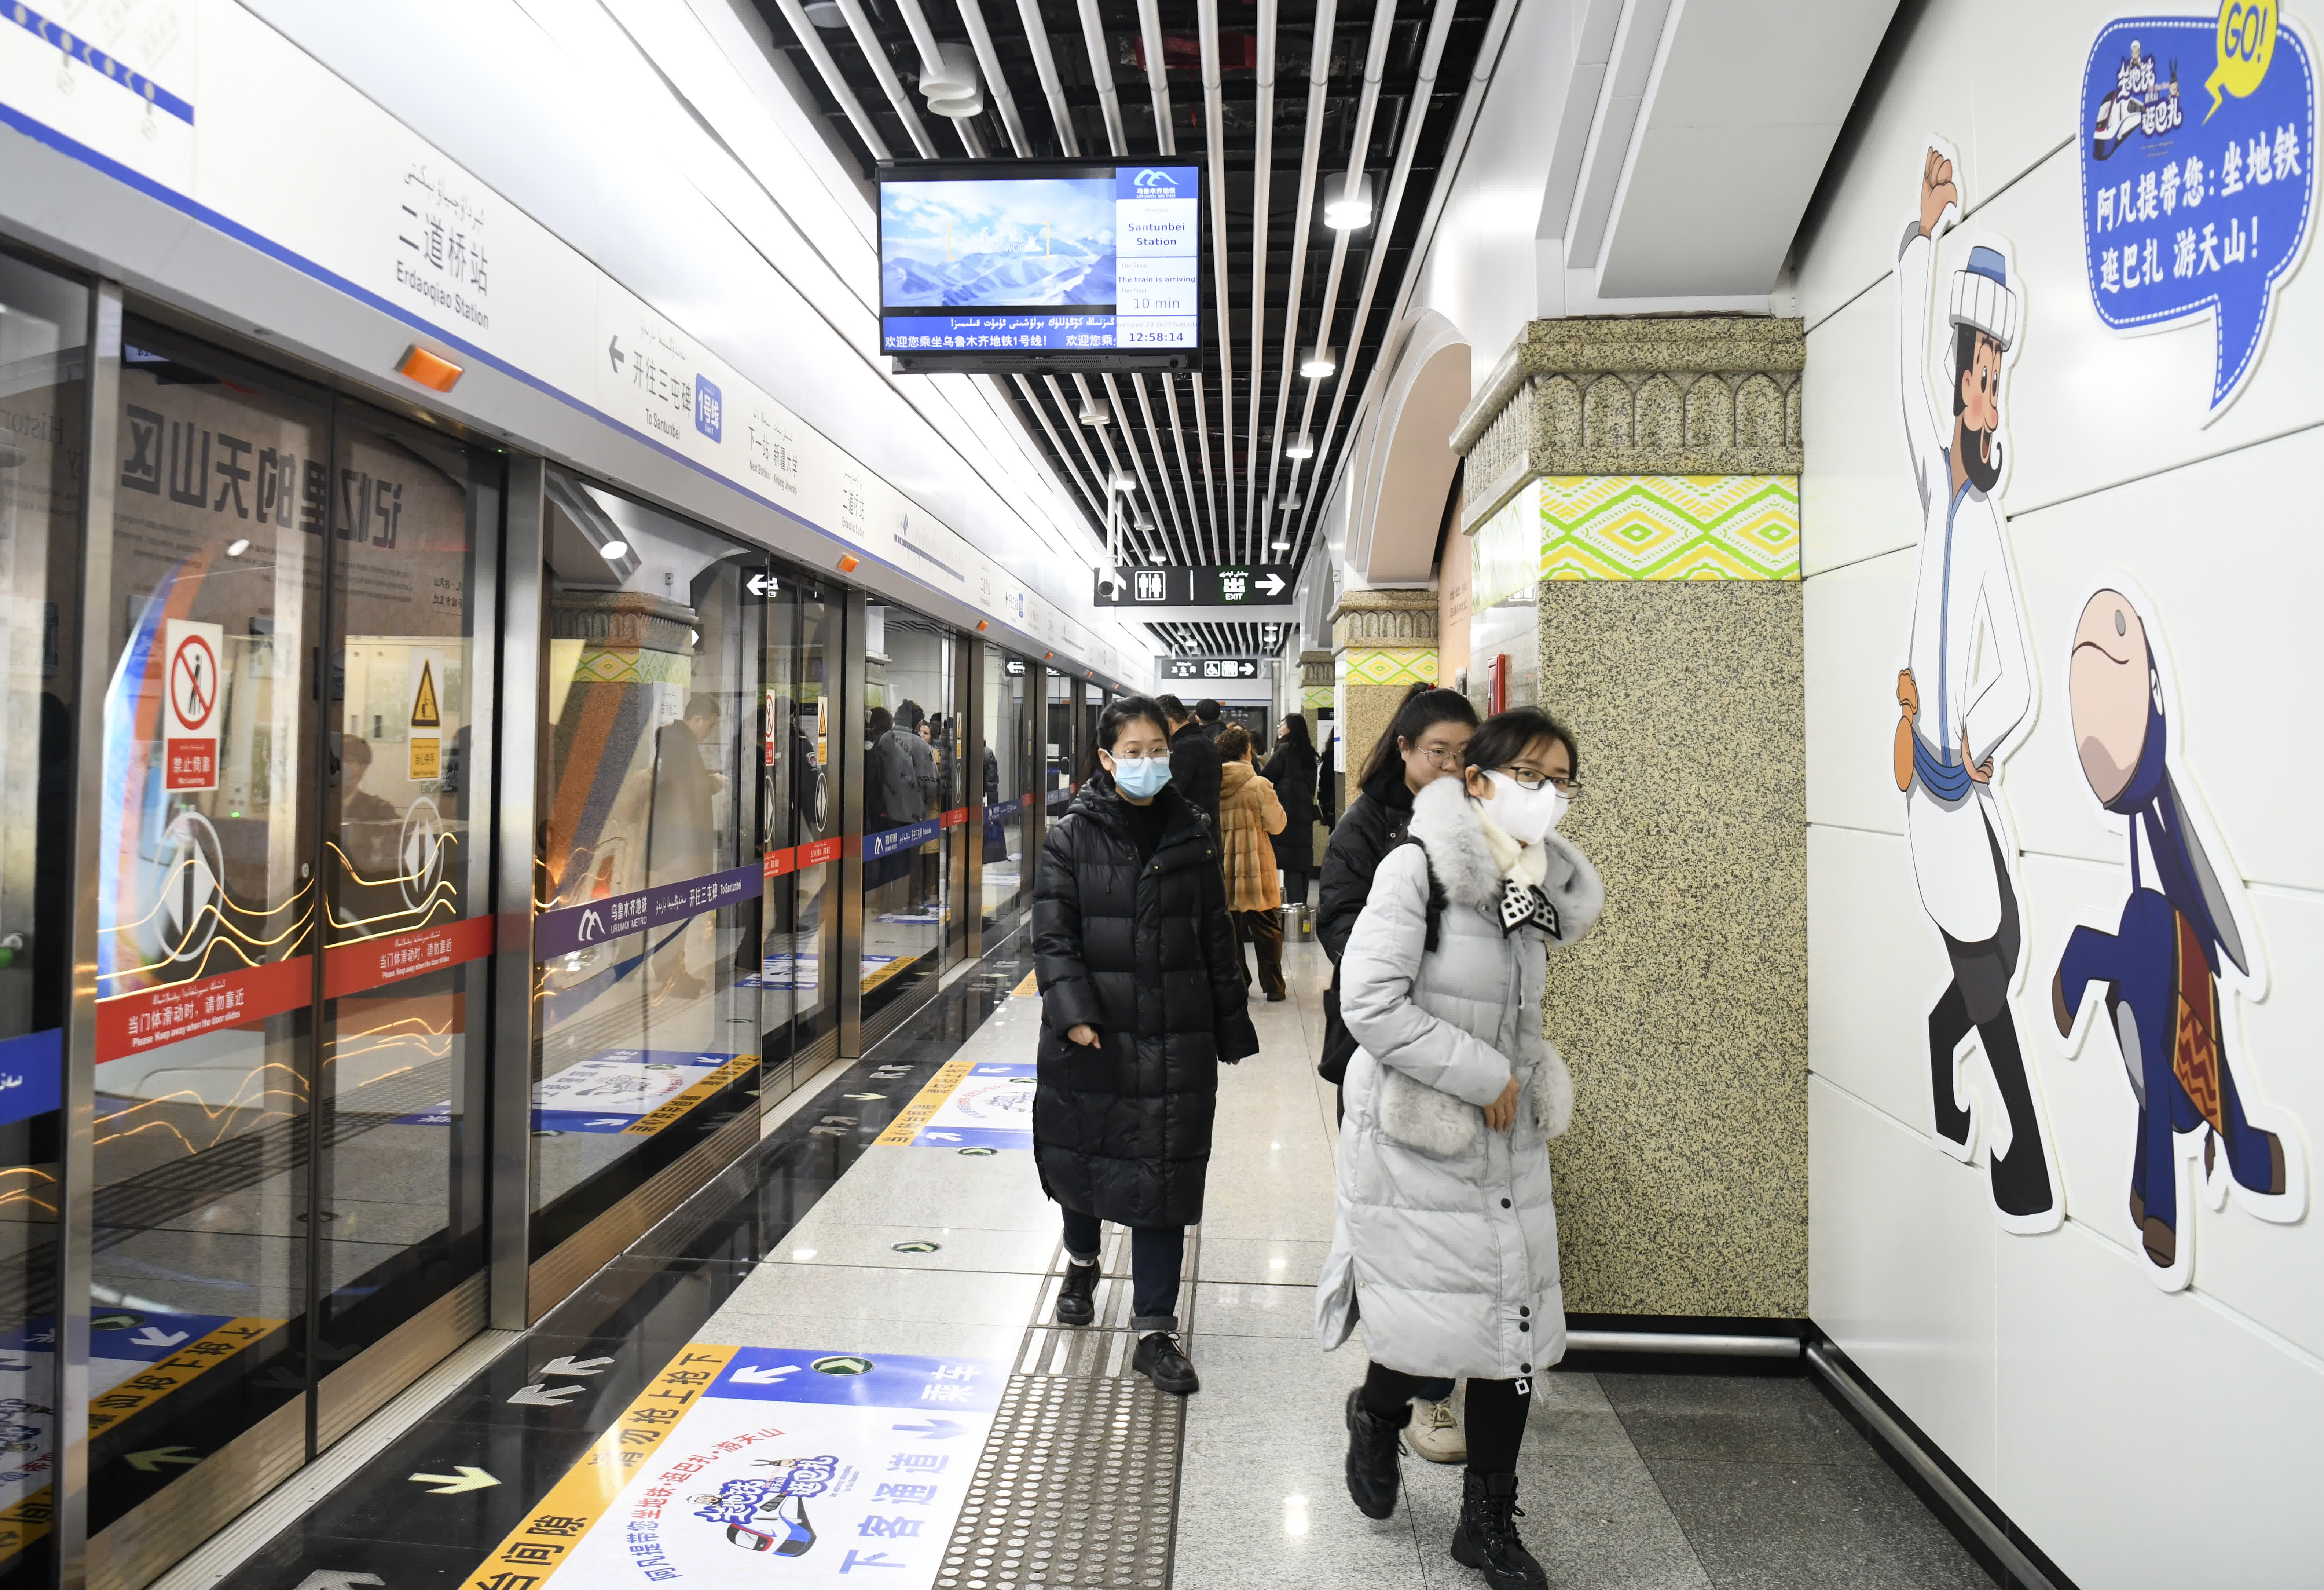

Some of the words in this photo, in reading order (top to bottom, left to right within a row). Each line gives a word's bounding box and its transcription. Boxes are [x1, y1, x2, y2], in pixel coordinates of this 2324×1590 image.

[2225, 2, 2268, 63] GO!
[2142, 98, 2182, 135] 逛巴扎
[1128, 222, 1185, 231] Santunbei
[1137, 237, 1177, 245] Station
[399, 204, 488, 296] 二道桥站
[2101, 238, 2163, 294] 逛巴扎
[396, 260, 452, 309] Erdaoqiao
[455, 294, 489, 330] Station
[1134, 298, 1150, 309] 10
[1155, 297, 1180, 309] min
[1129, 333, 1184, 342] 12:58:14
[633, 350, 692, 418] 开往三屯碑
[646, 408, 653, 425] To
[653, 413, 680, 441] Santunbei
[698, 390, 719, 430] 1号线
[842, 489, 865, 521] 二道桥站
[689, 883, 718, 908] 开往三屯碑
[720, 885, 725, 895] To
[725, 880, 742, 894] Santunbei
[611, 896, 648, 921] 乌鲁木齐地铁
[611, 921, 630, 934] URUMQI
[631, 916, 647, 928] METRO
[132, 1035, 153, 1048] Please
[155, 1030, 171, 1041] Keep
[171, 1026, 186, 1036] away
[186, 1021, 202, 1032] when
[202, 1018, 212, 1027] the
[212, 1015, 225, 1025] door
[225, 1010, 241, 1021] slides
[838, 1452, 949, 1574] 下客通道
